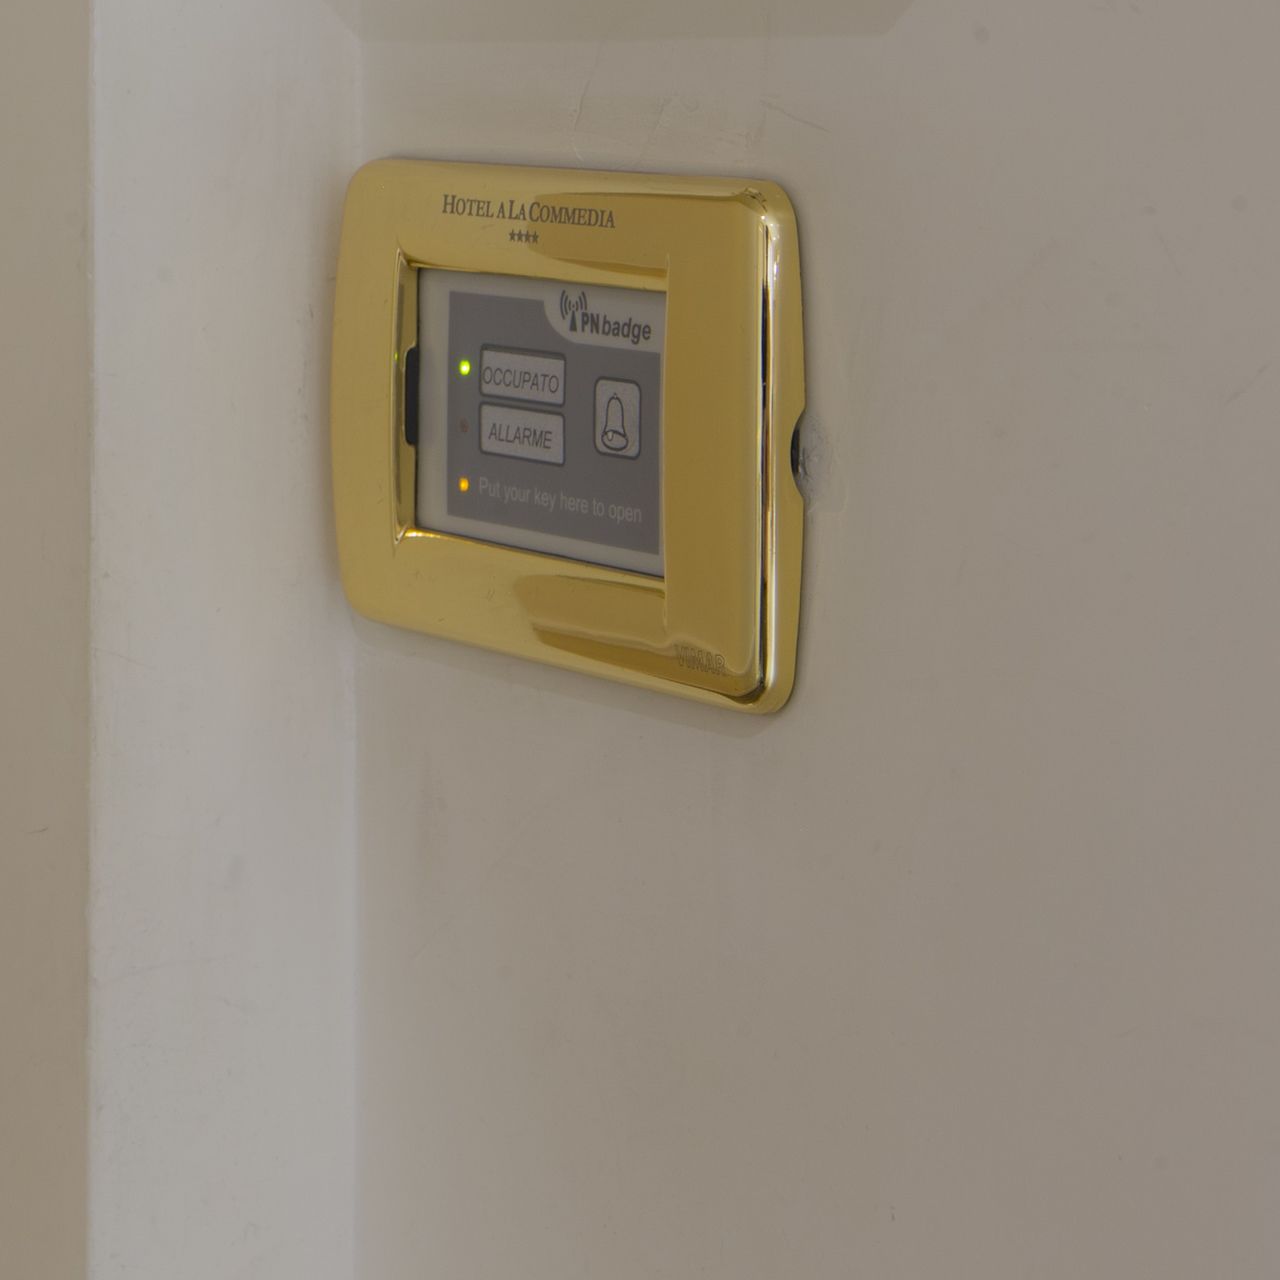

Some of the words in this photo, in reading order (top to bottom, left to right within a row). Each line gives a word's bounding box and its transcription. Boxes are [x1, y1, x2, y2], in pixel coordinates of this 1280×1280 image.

[442, 194, 494, 218] HOTEL
[529, 201, 616, 228] COMMEDIA
[481, 366, 560, 394] OCCUPATO
[488, 422, 553, 449] ALLARME
[479, 476, 501, 498] Put
[503, 485, 531, 504] your
[534, 488, 557, 513] key
[559, 491, 589, 514] here
[592, 498, 605, 517] to
[608, 503, 643, 524] open
